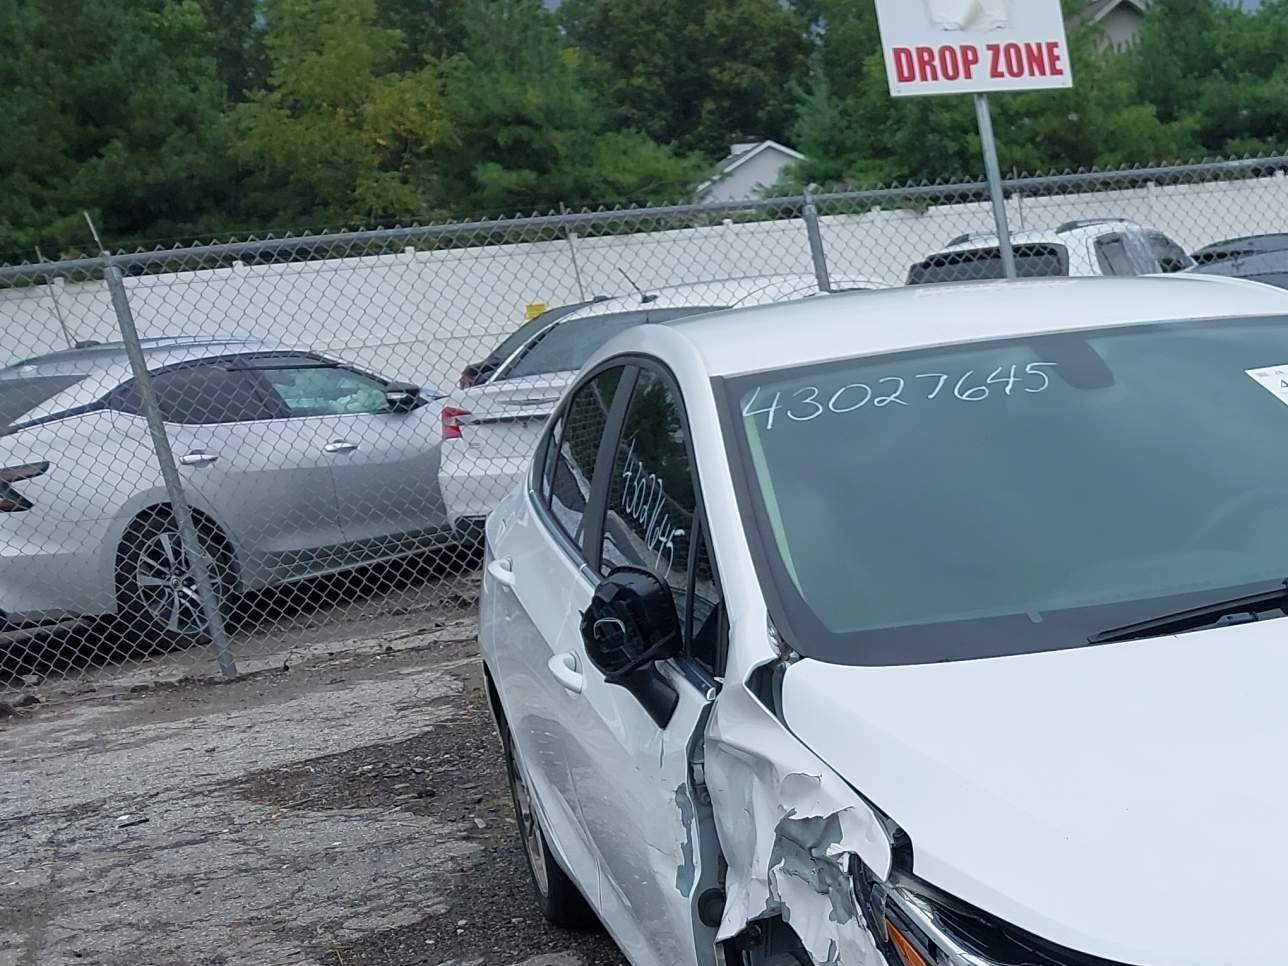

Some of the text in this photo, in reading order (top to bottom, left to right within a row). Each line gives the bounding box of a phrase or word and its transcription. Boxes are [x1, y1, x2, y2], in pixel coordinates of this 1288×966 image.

[892, 42, 1063, 83] DROP ZONE
[742, 362, 1057, 430] 43027645
